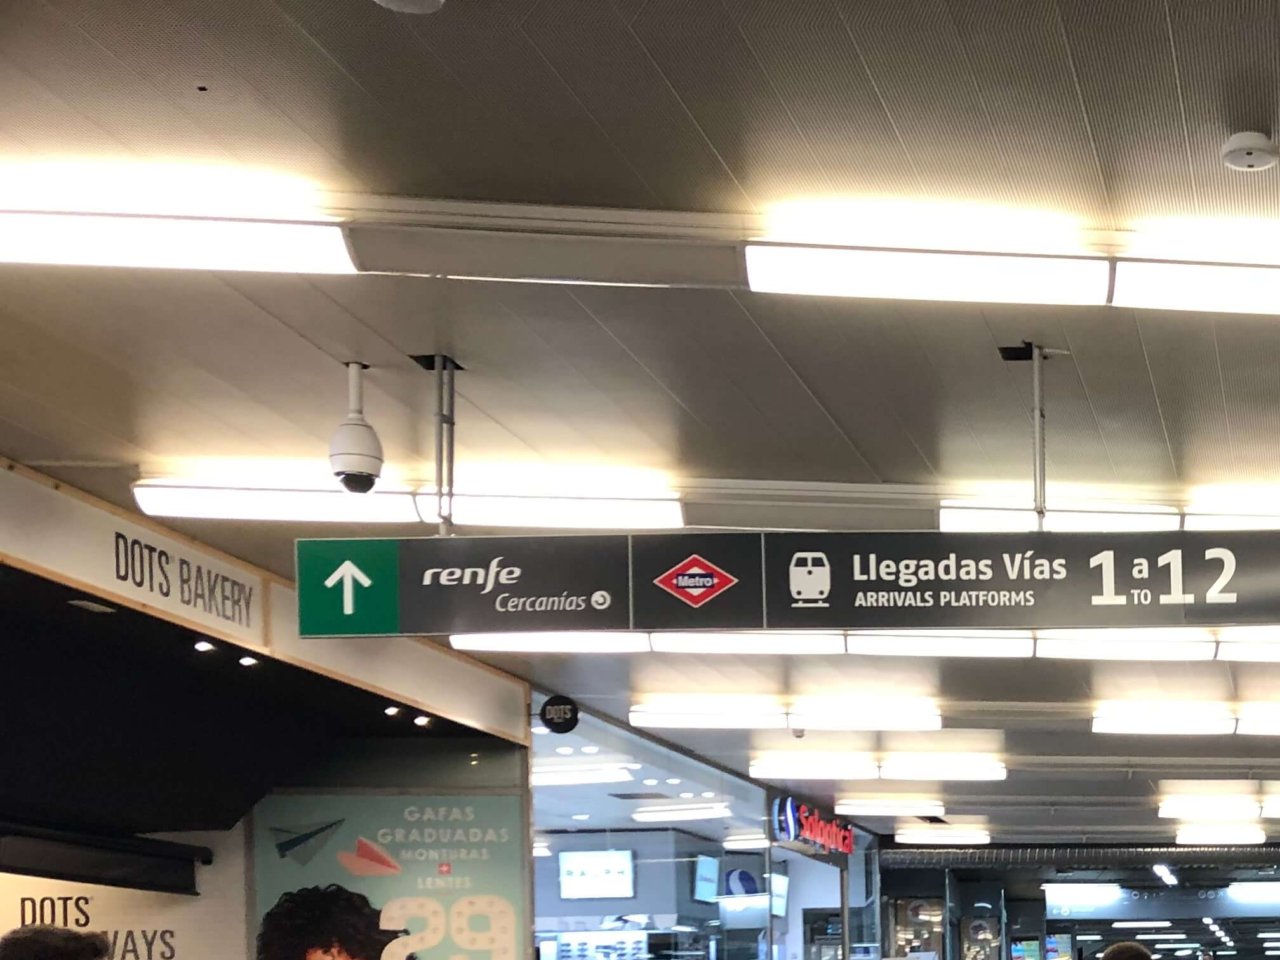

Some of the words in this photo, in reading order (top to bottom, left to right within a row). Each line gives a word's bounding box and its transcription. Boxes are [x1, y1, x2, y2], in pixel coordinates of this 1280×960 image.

[115, 531, 170, 597] DOTS
[179, 558, 252, 628] BAKERY
[422, 556, 521, 594] renfe
[677, 576, 713, 587] Metro
[853, 553, 993, 587] Llegadas
[1002, 550, 1067, 580] Vías
[1089, 550, 1127, 605] 1
[1132, 558, 1149, 579] a
[1157, 547, 1238, 605] 12
[495, 591, 587, 611] Cercanías
[854, 591, 934, 607] ARRIVALS
[940, 590, 1035, 606] PLATFORMS
[1131, 589, 1152, 605] TO
[546, 705, 571, 719] DOTS
[404, 806, 474, 821] GAFAS
[377, 828, 509, 843] GRADUADAS
[401, 848, 489, 861] MONTURAS
[416, 877, 472, 889] LENTES
[20, 896, 90, 927] DOTS
